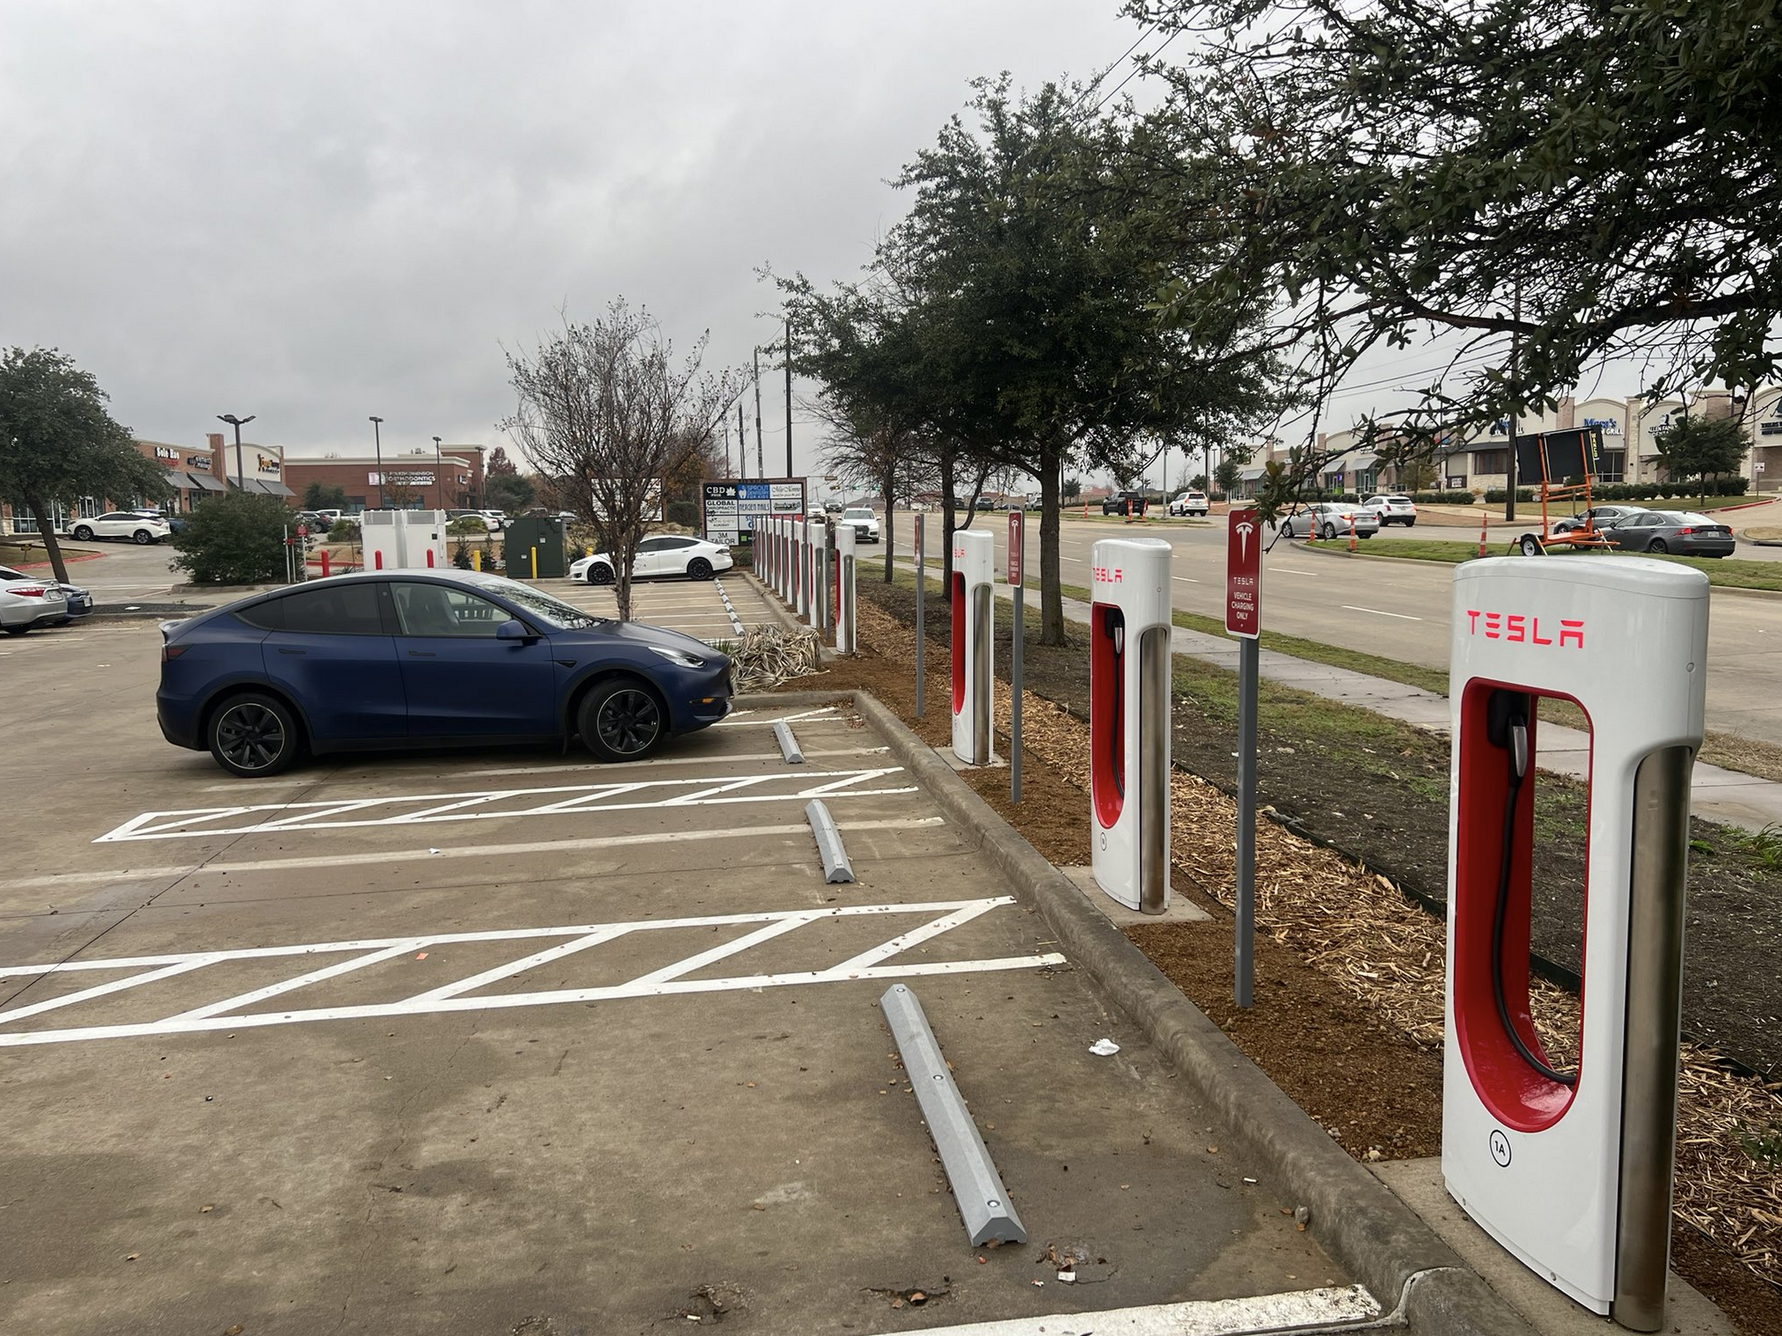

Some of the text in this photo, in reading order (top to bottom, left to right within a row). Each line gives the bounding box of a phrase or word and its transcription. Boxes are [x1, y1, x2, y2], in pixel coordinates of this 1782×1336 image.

[706, 486, 726, 494] CBD
[1233, 576, 1254, 585] TESLA
[1233, 591, 1252, 601] VEHICLE
[1231, 602, 1254, 611] CHARGING
[1236, 611, 1249, 620] ONLY
[1467, 610, 1584, 649] TESLA
[1494, 1140, 1506, 1157] 1A
